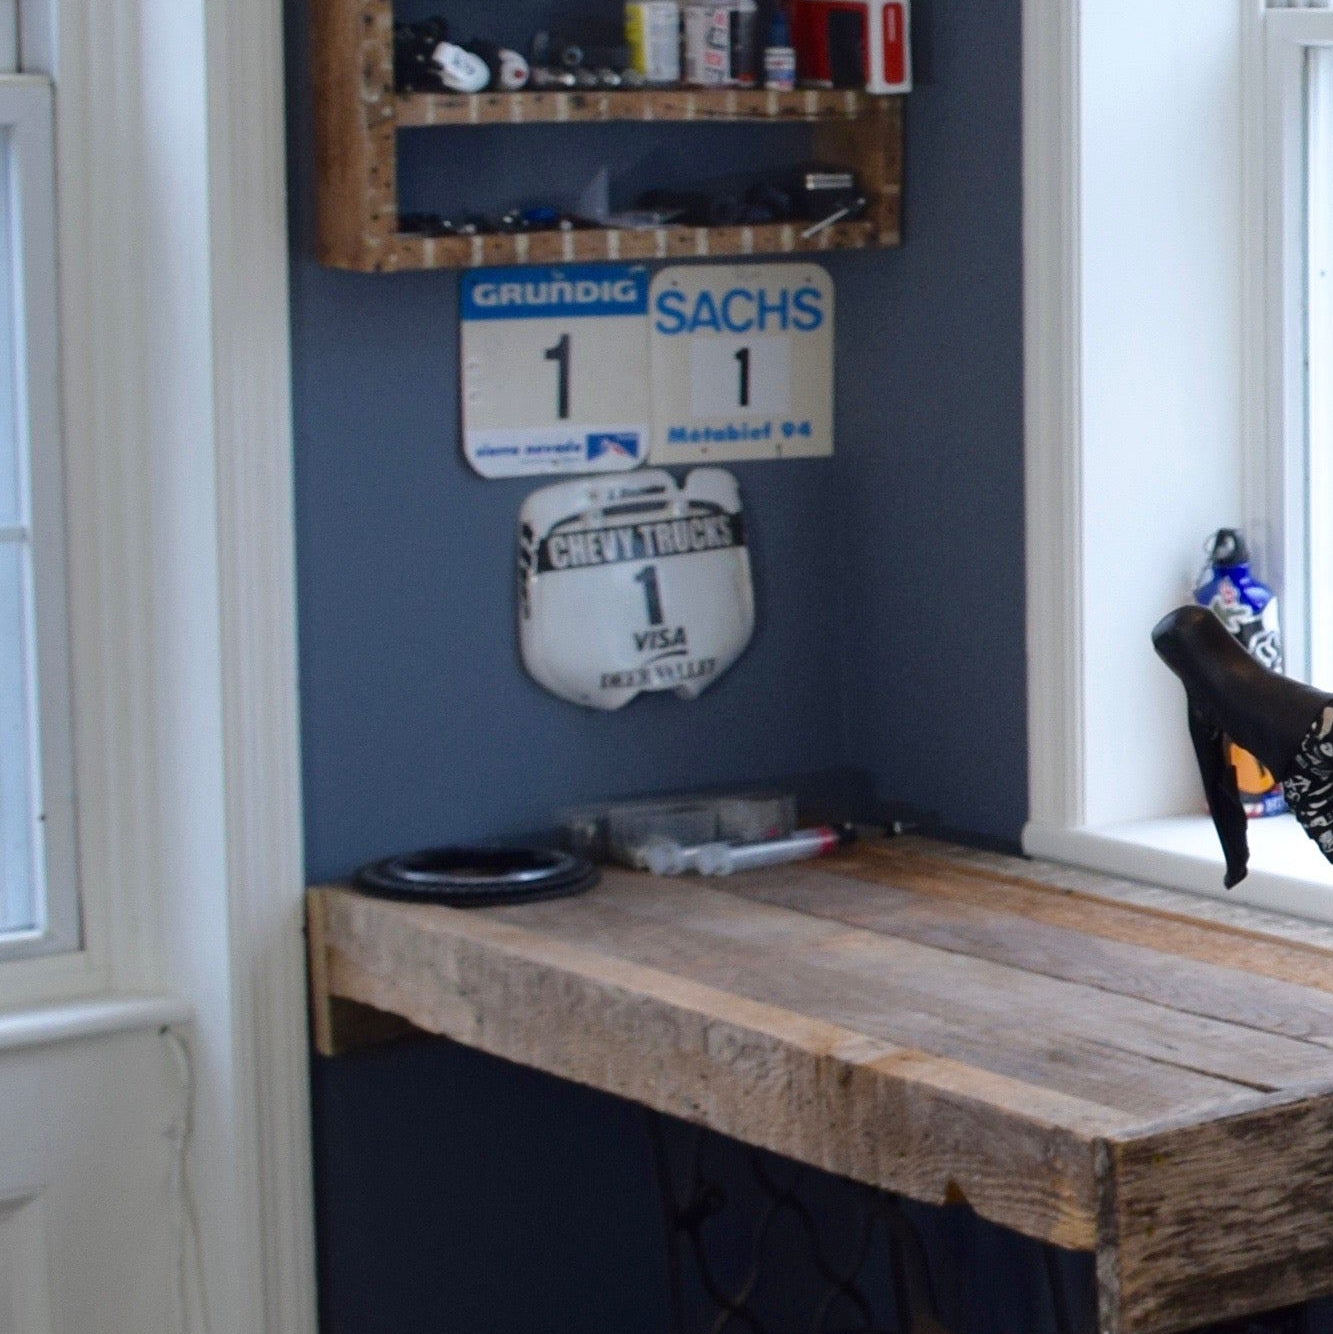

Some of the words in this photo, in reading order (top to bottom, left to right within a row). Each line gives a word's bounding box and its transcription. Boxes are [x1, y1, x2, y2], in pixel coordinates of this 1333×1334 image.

[472, 278, 638, 307] GRUNDIG
[654, 287, 823, 335] SACHS
[543, 333, 571, 419] 1
[734, 347, 751, 407] 1
[549, 528, 634, 568] CHEVY
[638, 515, 734, 559] TRUCKS
[633, 564, 664, 626] 1
[633, 626, 687, 652] VISA
